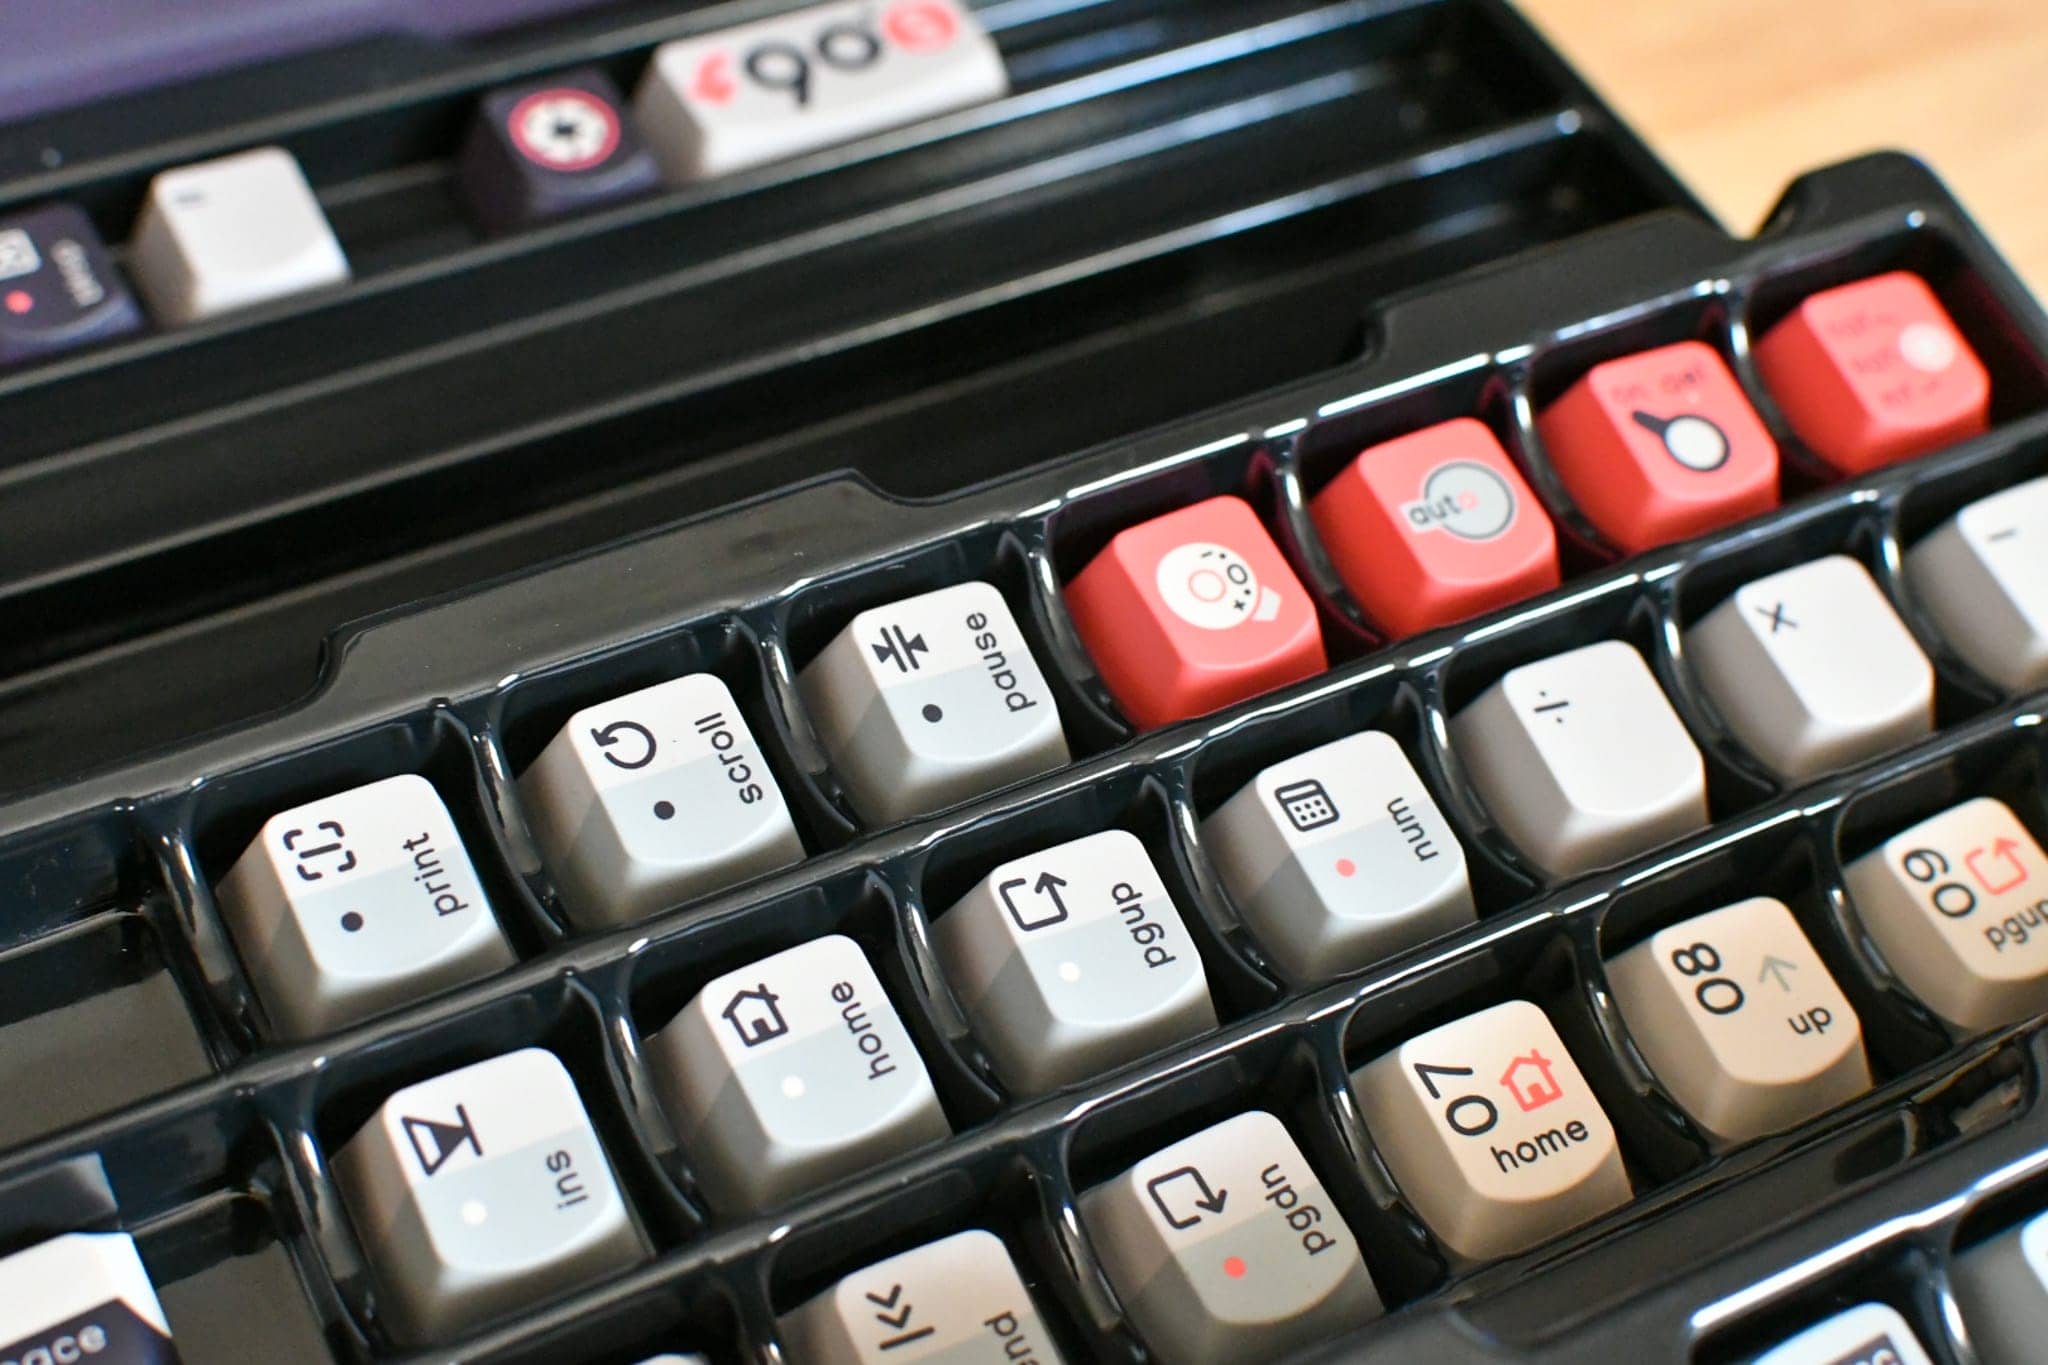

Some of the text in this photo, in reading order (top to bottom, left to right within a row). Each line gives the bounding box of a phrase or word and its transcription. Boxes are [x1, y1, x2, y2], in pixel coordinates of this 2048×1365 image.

[966, 610, 1037, 713] pause
[694, 711, 763, 805] scroll
[1387, 796, 1439, 862] num
[402, 831, 469, 917] print
[1111, 882, 1177, 969] pgup
[1671, 942, 1745, 1016] 08
[831, 981, 896, 1080] home
[1788, 1007, 1832, 1035] up
[546, 1150, 588, 1209] ins
[1490, 1120, 1589, 1173] home
[1261, 1164, 1335, 1256] pgdn
[0, 1324, 107, 1365] ace
